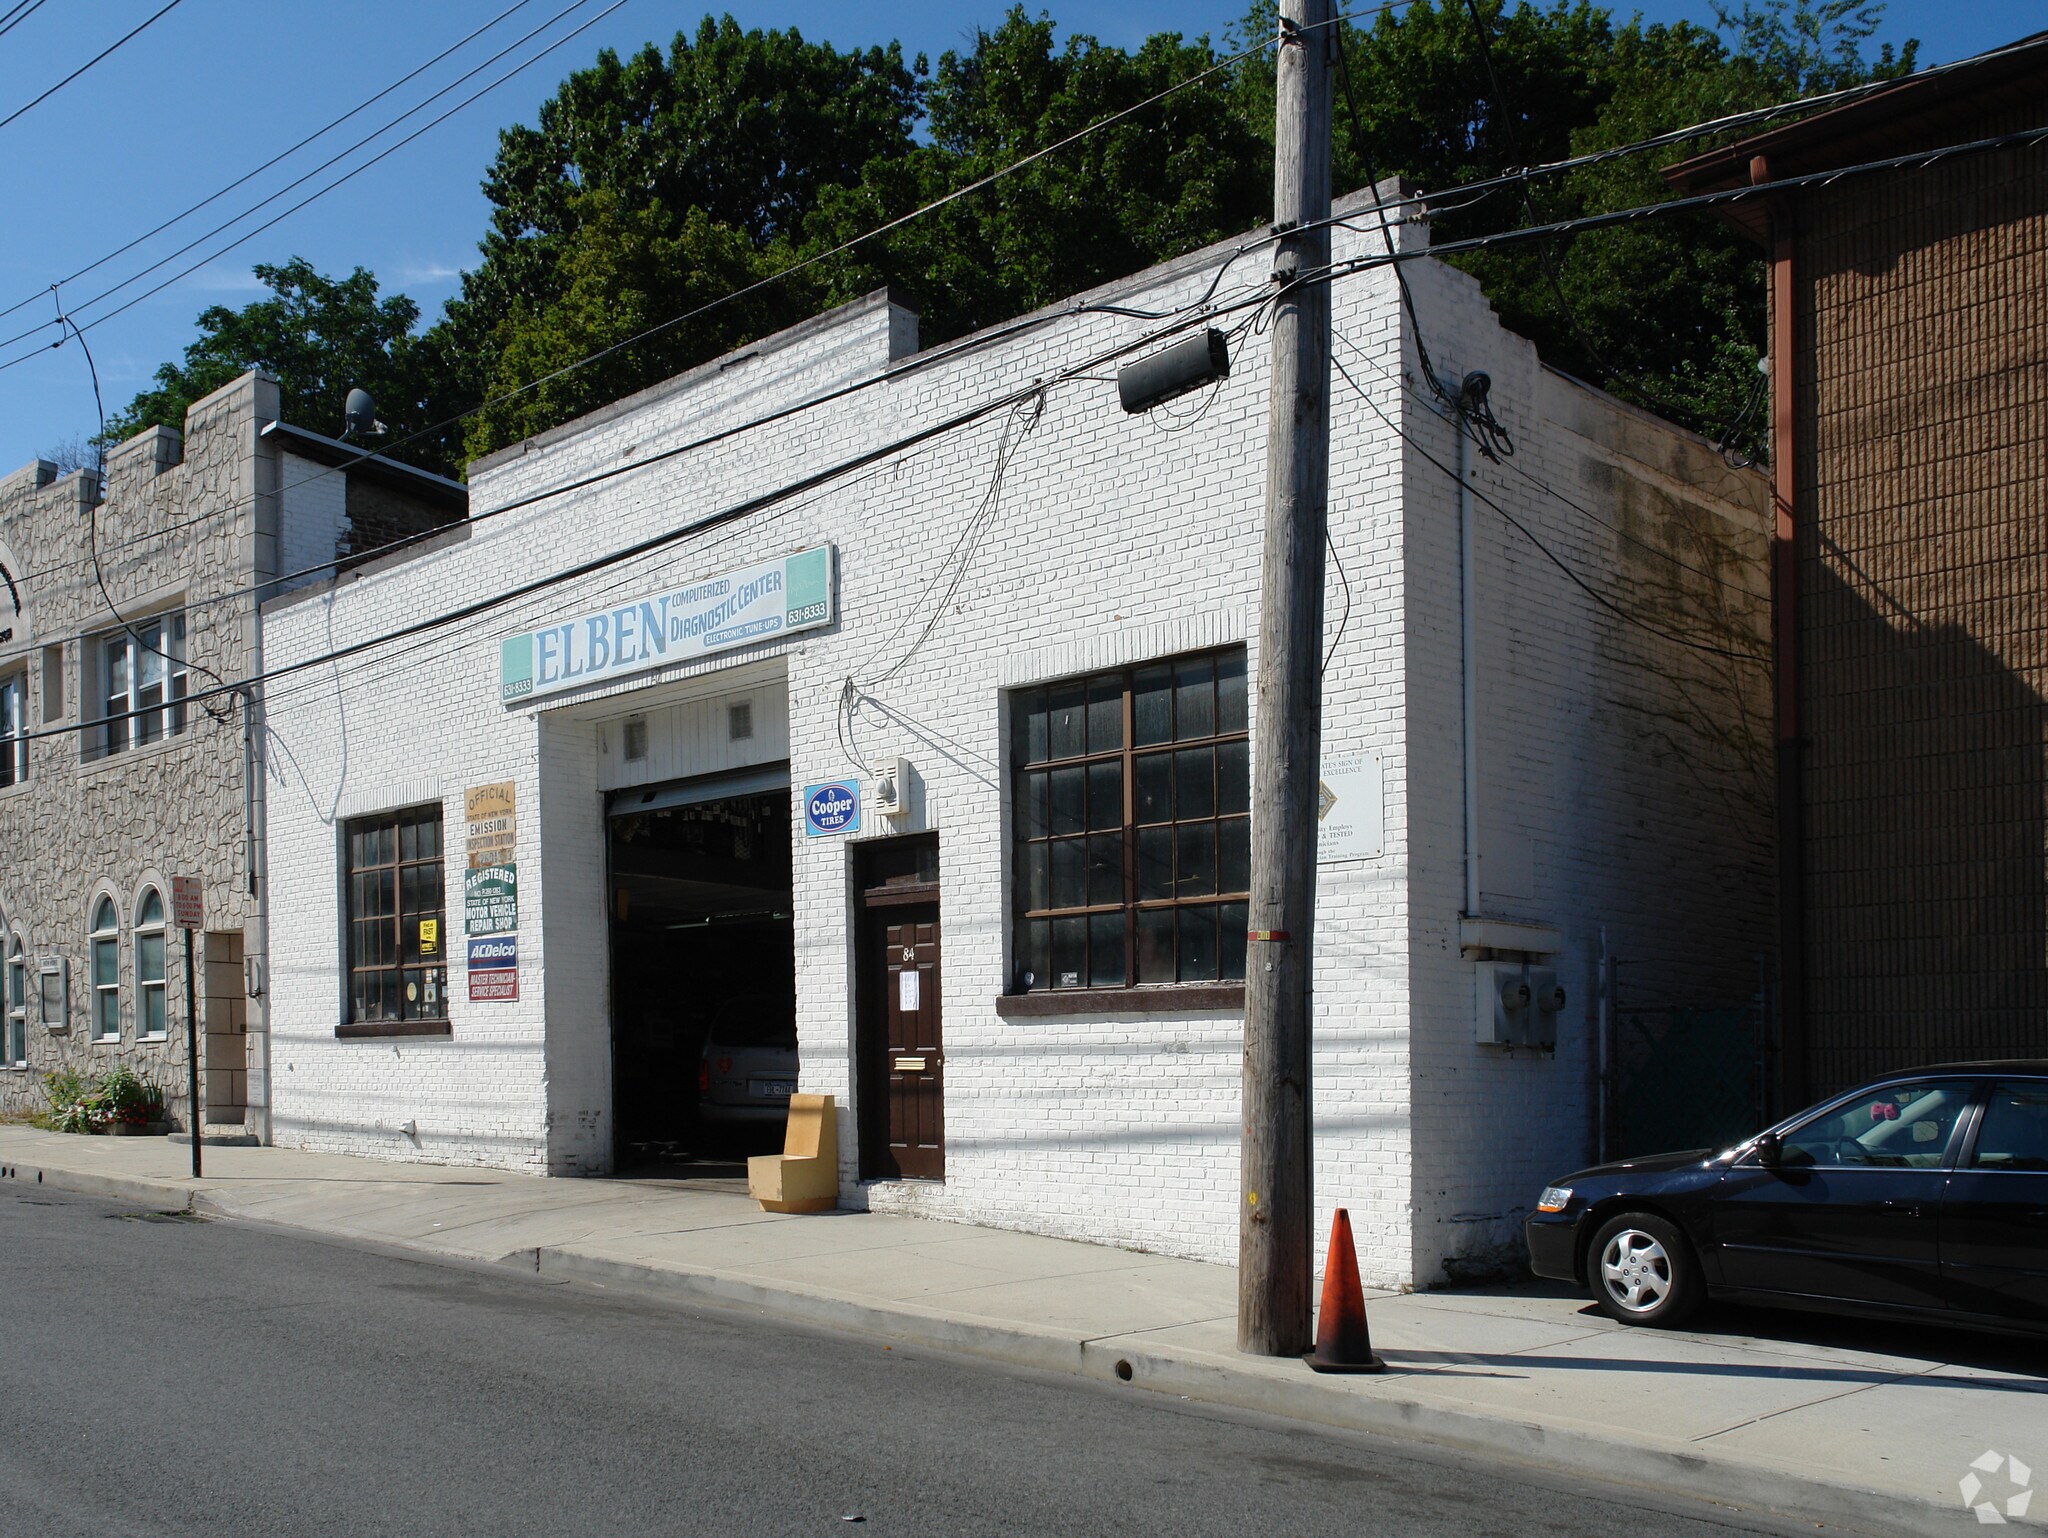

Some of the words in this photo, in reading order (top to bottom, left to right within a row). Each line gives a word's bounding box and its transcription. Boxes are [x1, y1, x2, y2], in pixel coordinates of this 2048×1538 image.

[672, 579, 731, 608] COMPUTERIZED
[671, 593, 738, 642] DIAGNOSTIC
[737, 570, 782, 611] CENTER
[706, 627, 743, 644] ELECTRONIC
[744, 618, 779, 634] TUNE-UPS
[536, 595, 671, 686] ELBEN
[1338, 760, 1353, 768] SIGN
[1354, 758, 1362, 766] OF
[1323, 767, 1361, 777] EXCELLENCE
[469, 787, 511, 810] OFFICIAL
[467, 814, 480, 822] STATE
[488, 810, 498, 818] NEW
[499, 808, 513, 817] YORK
[812, 799, 852, 816] Cooper
[470, 819, 507, 836] EMISSION
[821, 815, 844, 826] TIRES
[1329, 824, 1353, 832] Employs
[467, 835, 494, 850] INSPECTION
[495, 832, 514, 847] STATION
[1329, 831, 1353, 840] TESTED
[466, 868, 515, 891] REGISTERED
[466, 898, 481, 907] STATE
[490, 896, 500, 905] NEW
[501, 895, 515, 903] YORK
[466, 906, 488, 919] MOTOR
[490, 903, 516, 917] VEHICLE
[470, 918, 493, 932] REPAIR
[495, 917, 513, 930] SHOP
[470, 942, 516, 958] ACDelco
[903, 947, 915, 961] 84
[471, 974, 489, 986] MASTER
[471, 986, 489, 998] SERVICE
[489, 984, 514, 997] SPECIALIST
